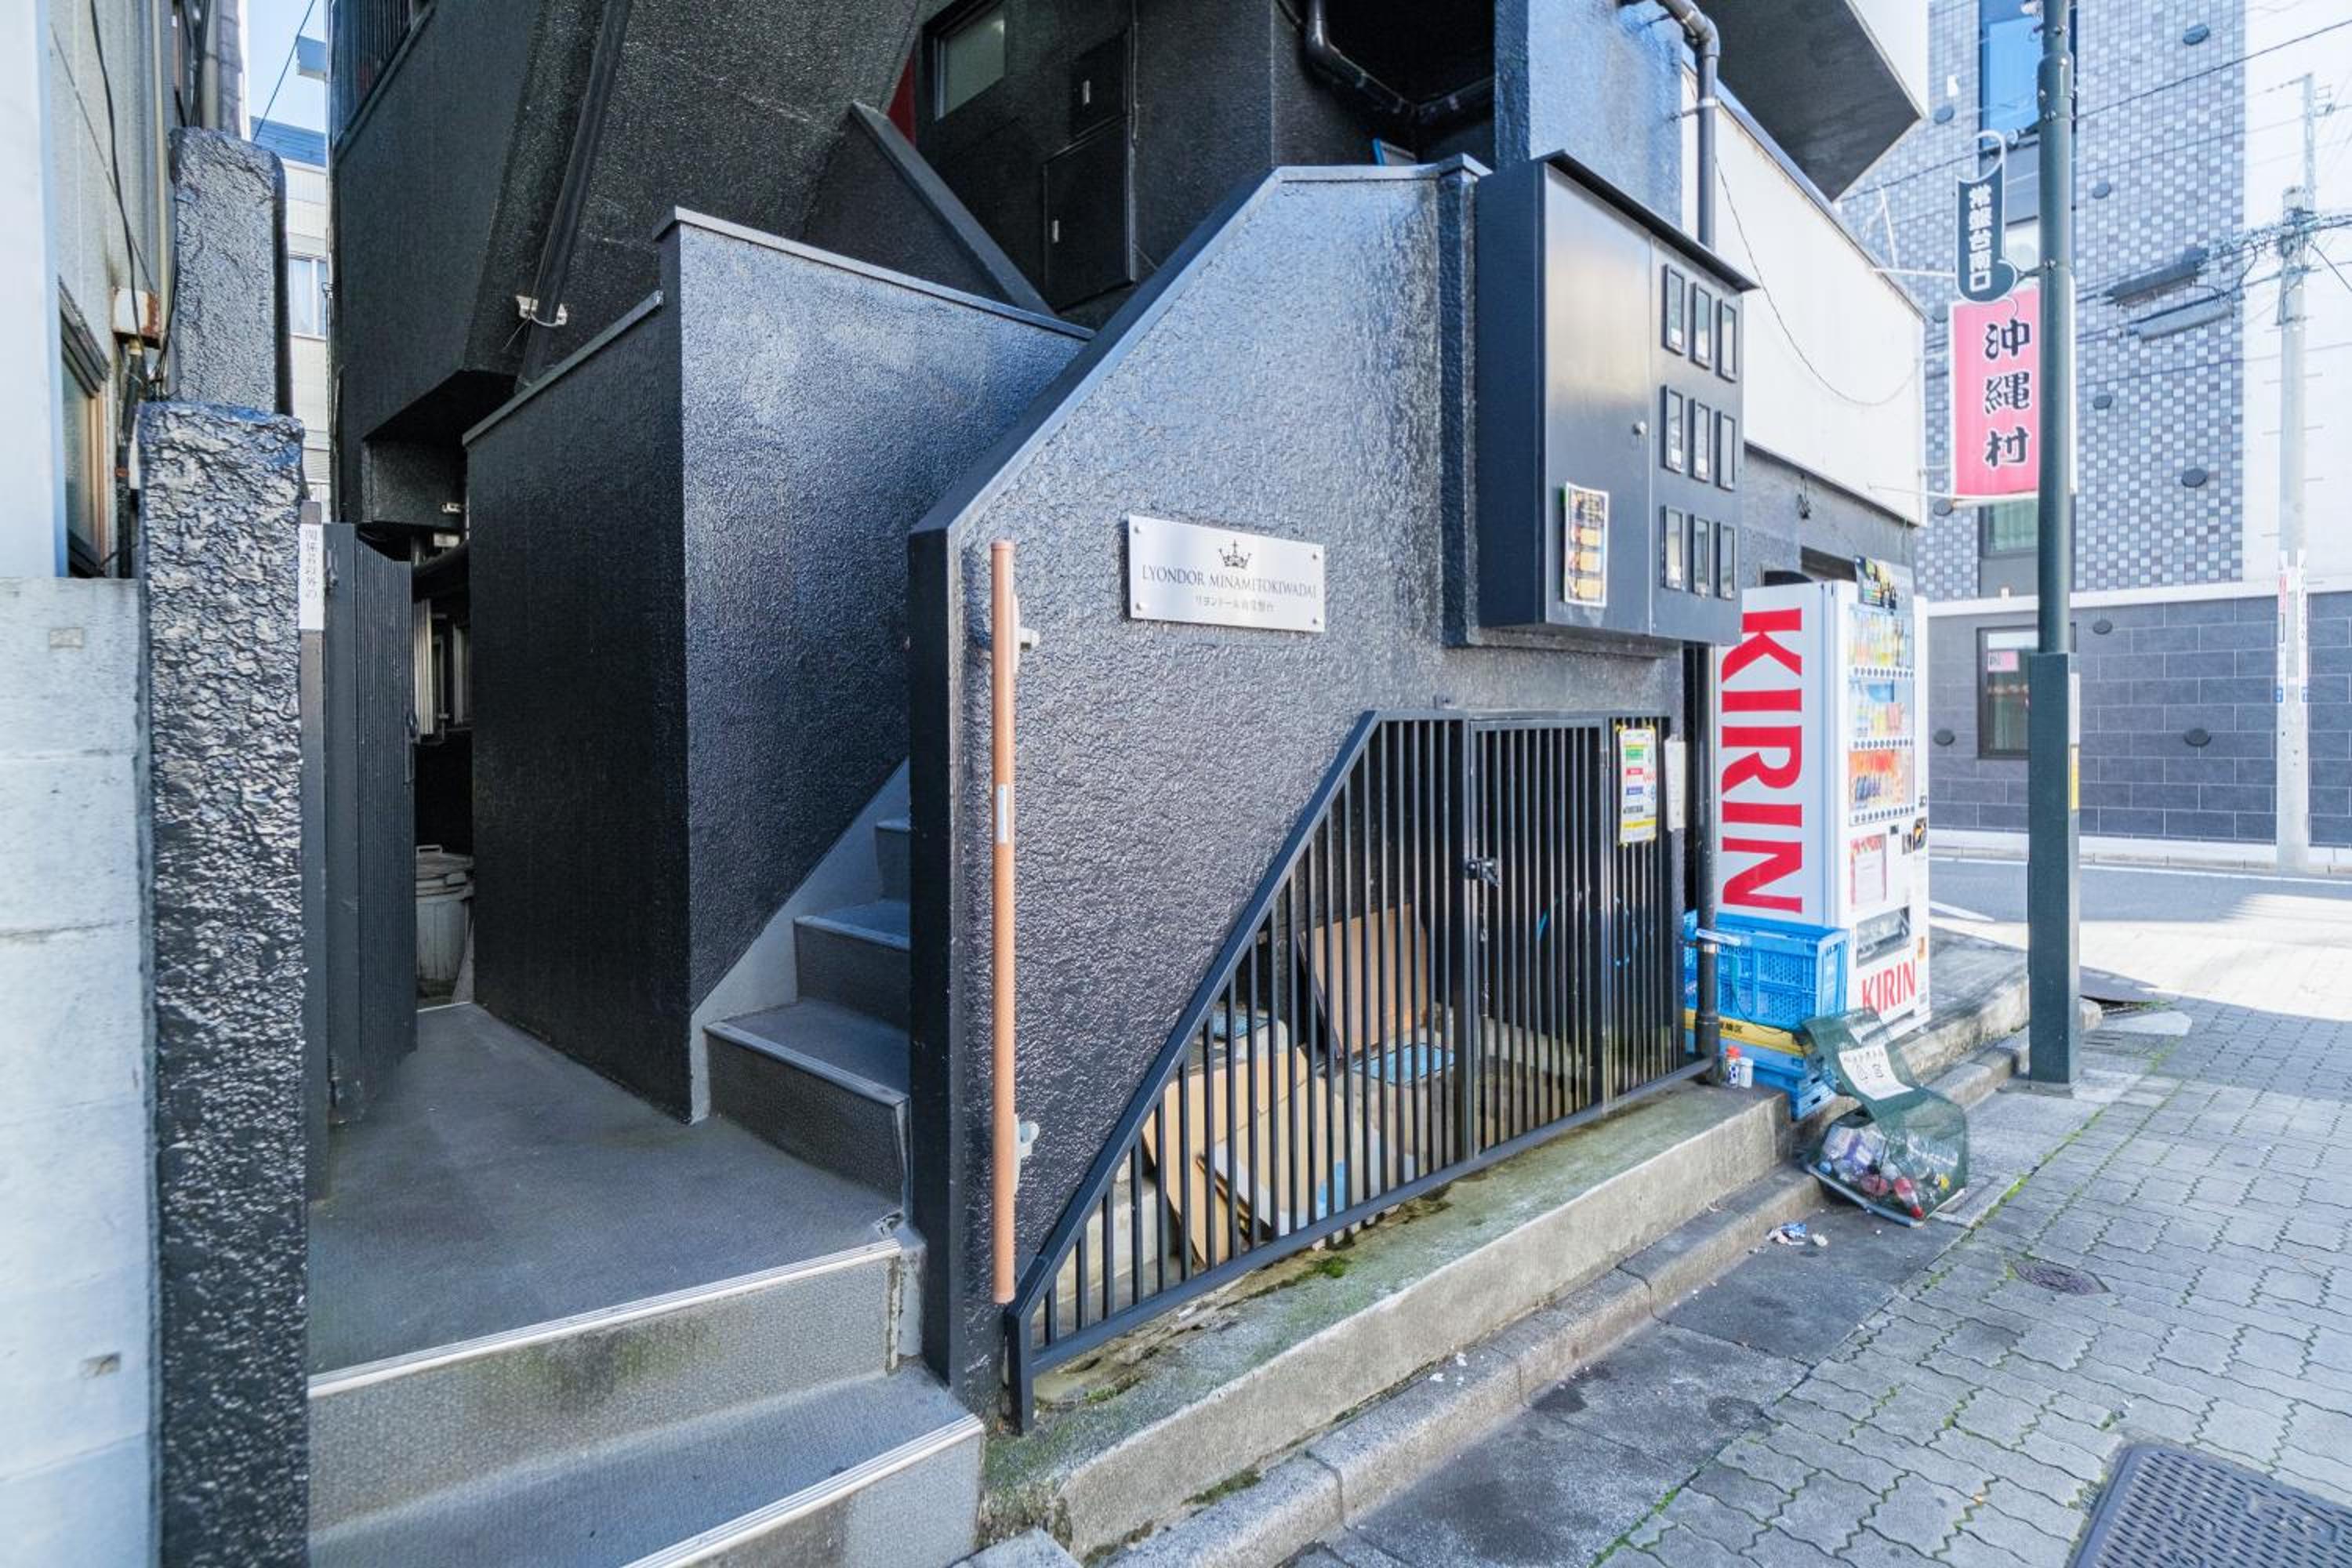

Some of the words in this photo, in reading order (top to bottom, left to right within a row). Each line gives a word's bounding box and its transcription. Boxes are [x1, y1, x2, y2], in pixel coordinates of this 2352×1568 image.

[1969, 183, 1992, 292] 常盤台南口
[1984, 318, 2032, 469] 沖縄村
[1142, 564, 1205, 586] LYONDOR
[1721, 608, 1802, 914] KIRIN
[1861, 959, 1916, 1014] KIRIN
